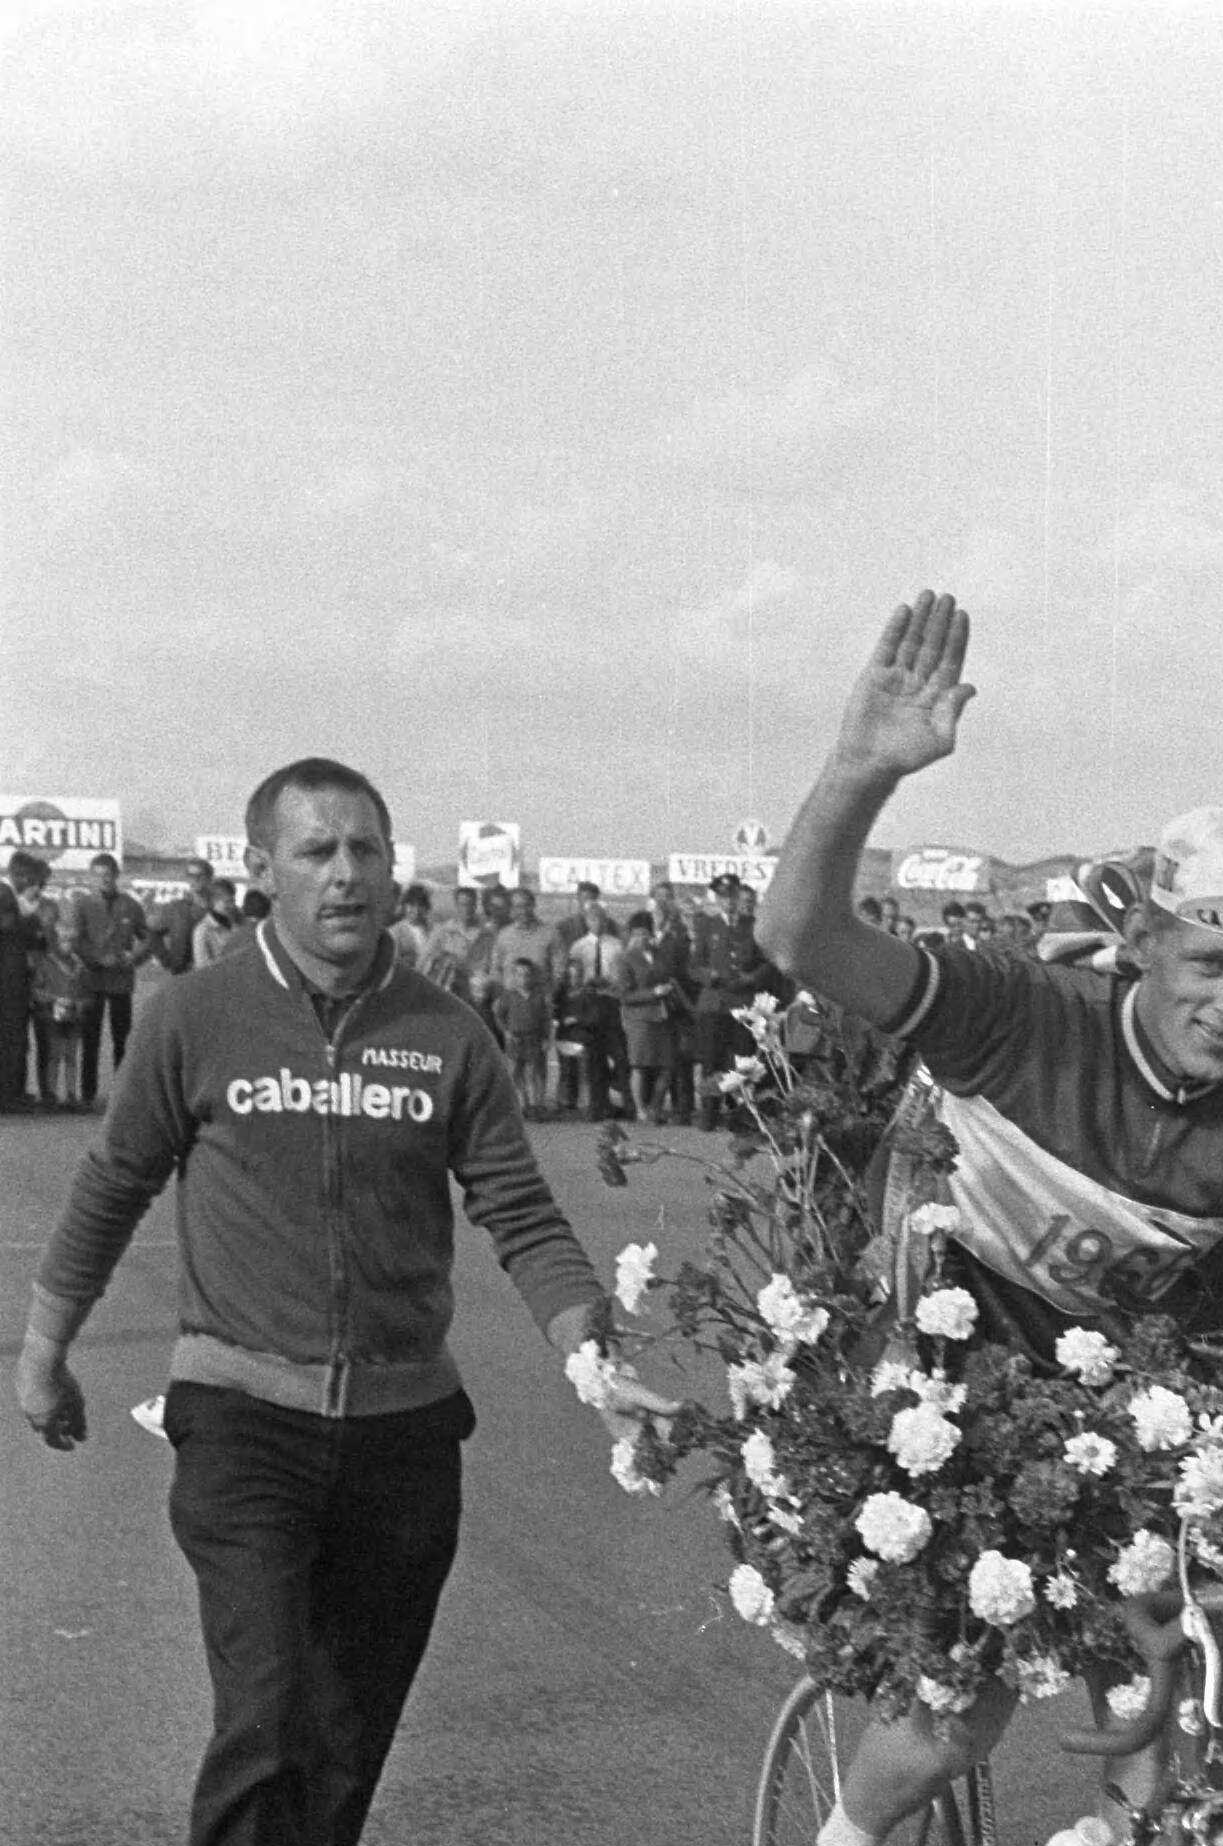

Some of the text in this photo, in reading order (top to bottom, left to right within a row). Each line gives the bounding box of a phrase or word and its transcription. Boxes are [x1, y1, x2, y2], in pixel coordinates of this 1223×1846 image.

[0, 816, 113, 848] ARTINI
[544, 861, 645, 890] CALTEX
[361, 1047, 443, 1075] MASSEUR
[226, 1066, 434, 1123] caballero
